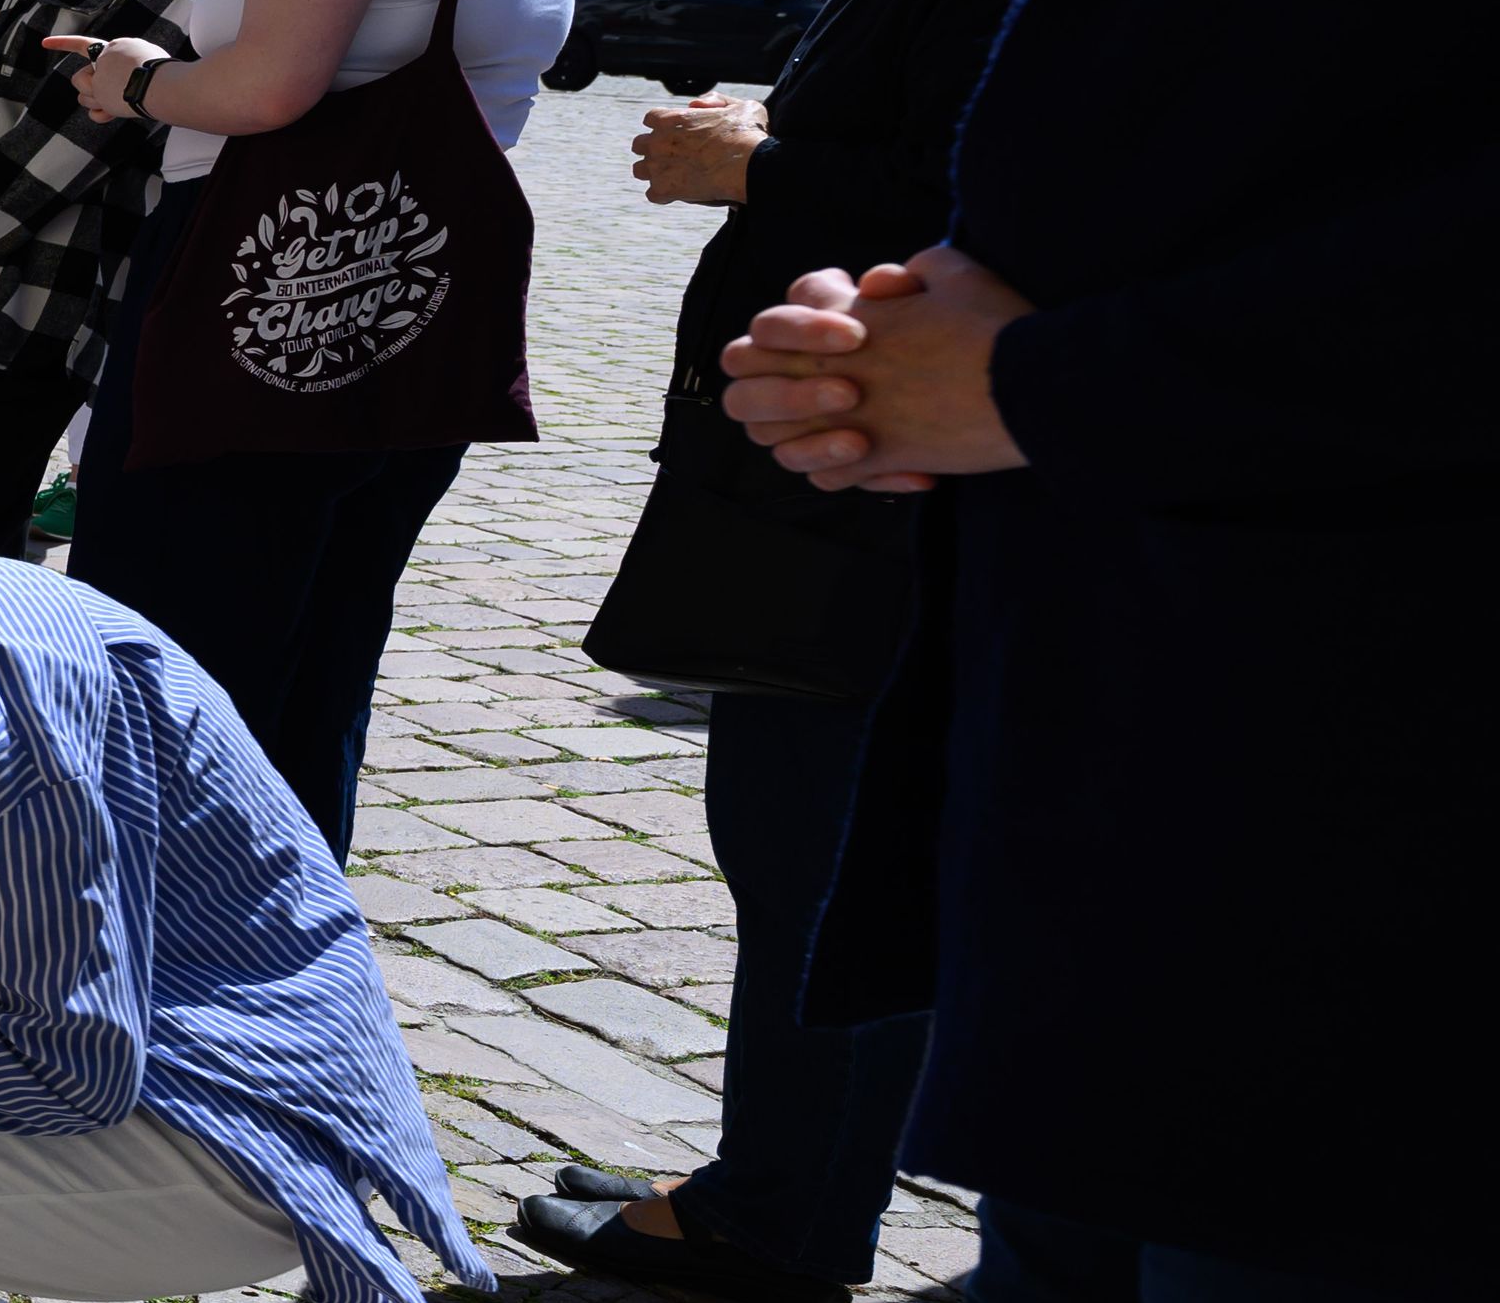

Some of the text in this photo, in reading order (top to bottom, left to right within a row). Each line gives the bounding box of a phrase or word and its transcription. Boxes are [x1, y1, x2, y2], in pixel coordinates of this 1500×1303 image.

[271, 217, 399, 279] Get up
[276, 258, 390, 297] GO INTERNATIONAL
[247, 279, 406, 342] Change
[279, 321, 357, 355] YOUR WORLD
